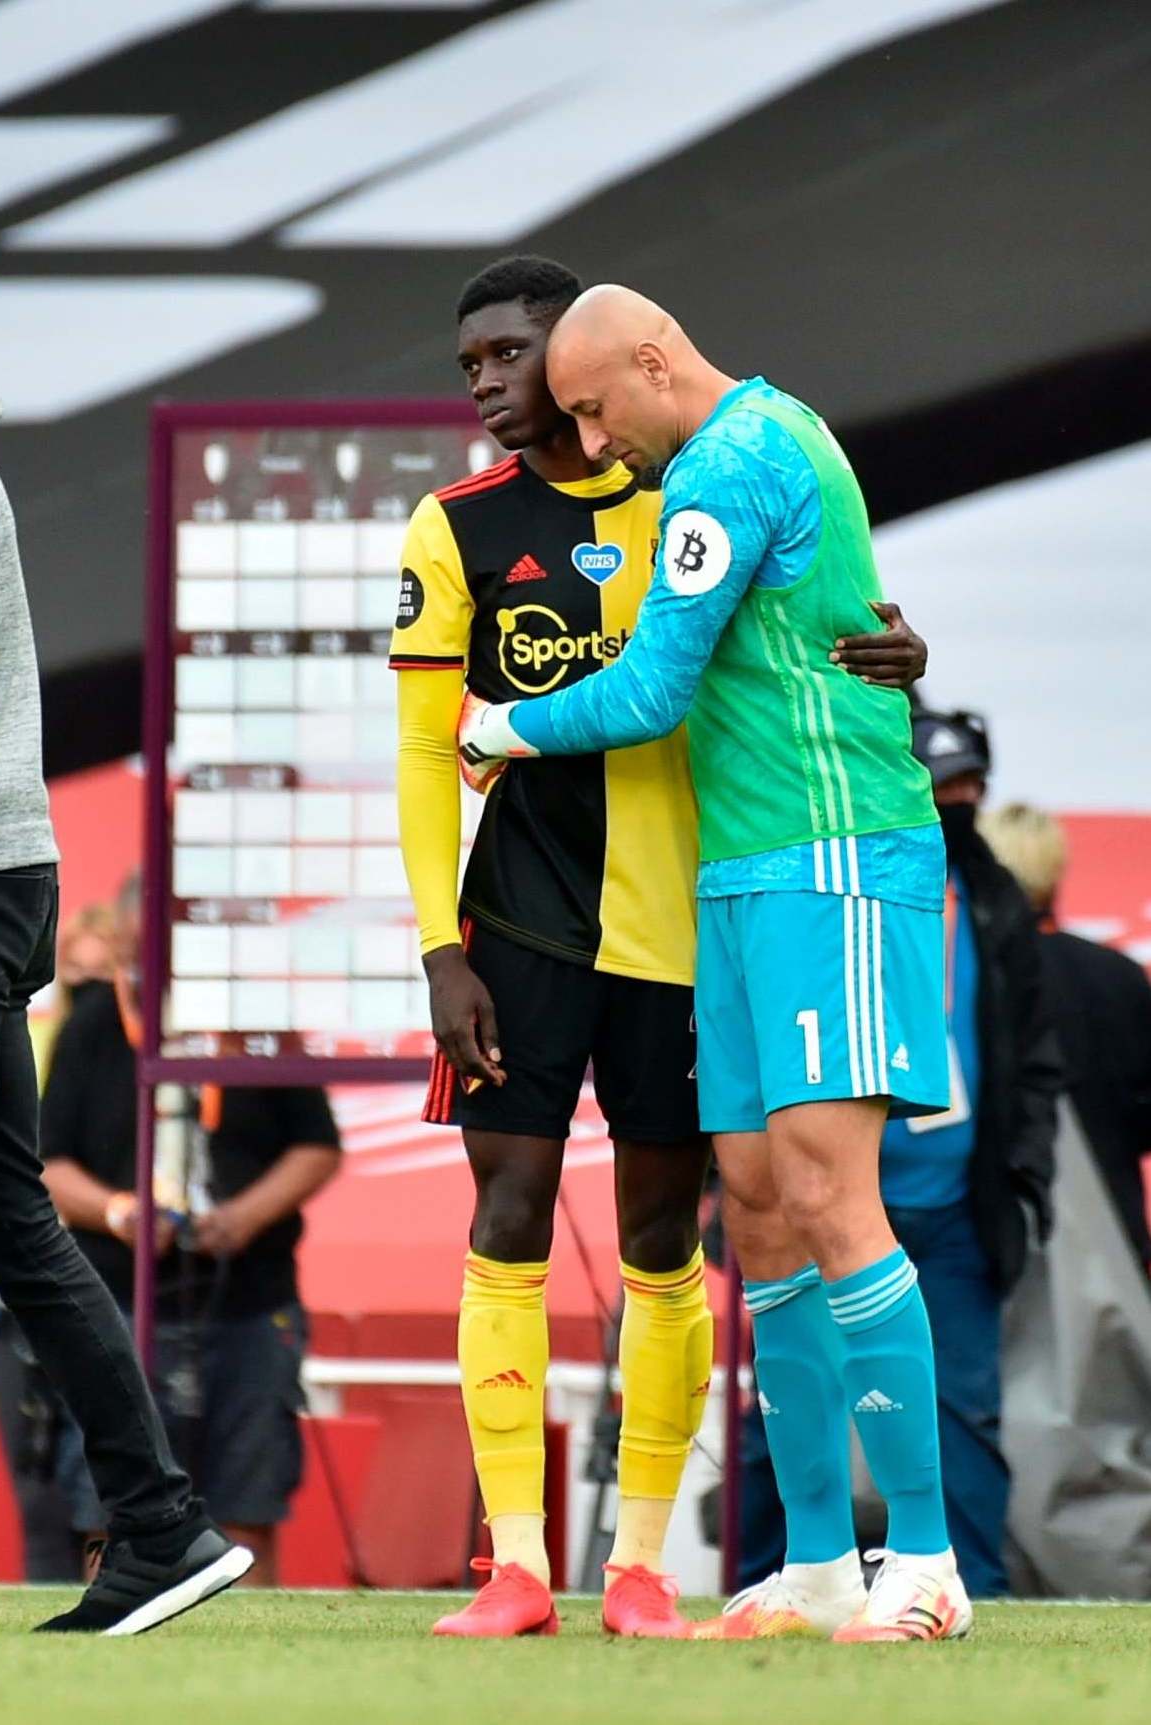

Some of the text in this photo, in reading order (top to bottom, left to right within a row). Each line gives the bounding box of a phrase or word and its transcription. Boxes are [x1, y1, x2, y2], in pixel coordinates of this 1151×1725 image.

[583, 555, 614, 568] NHS
[506, 569, 547, 583] adidas
[795, 1008, 822, 1085] 1
